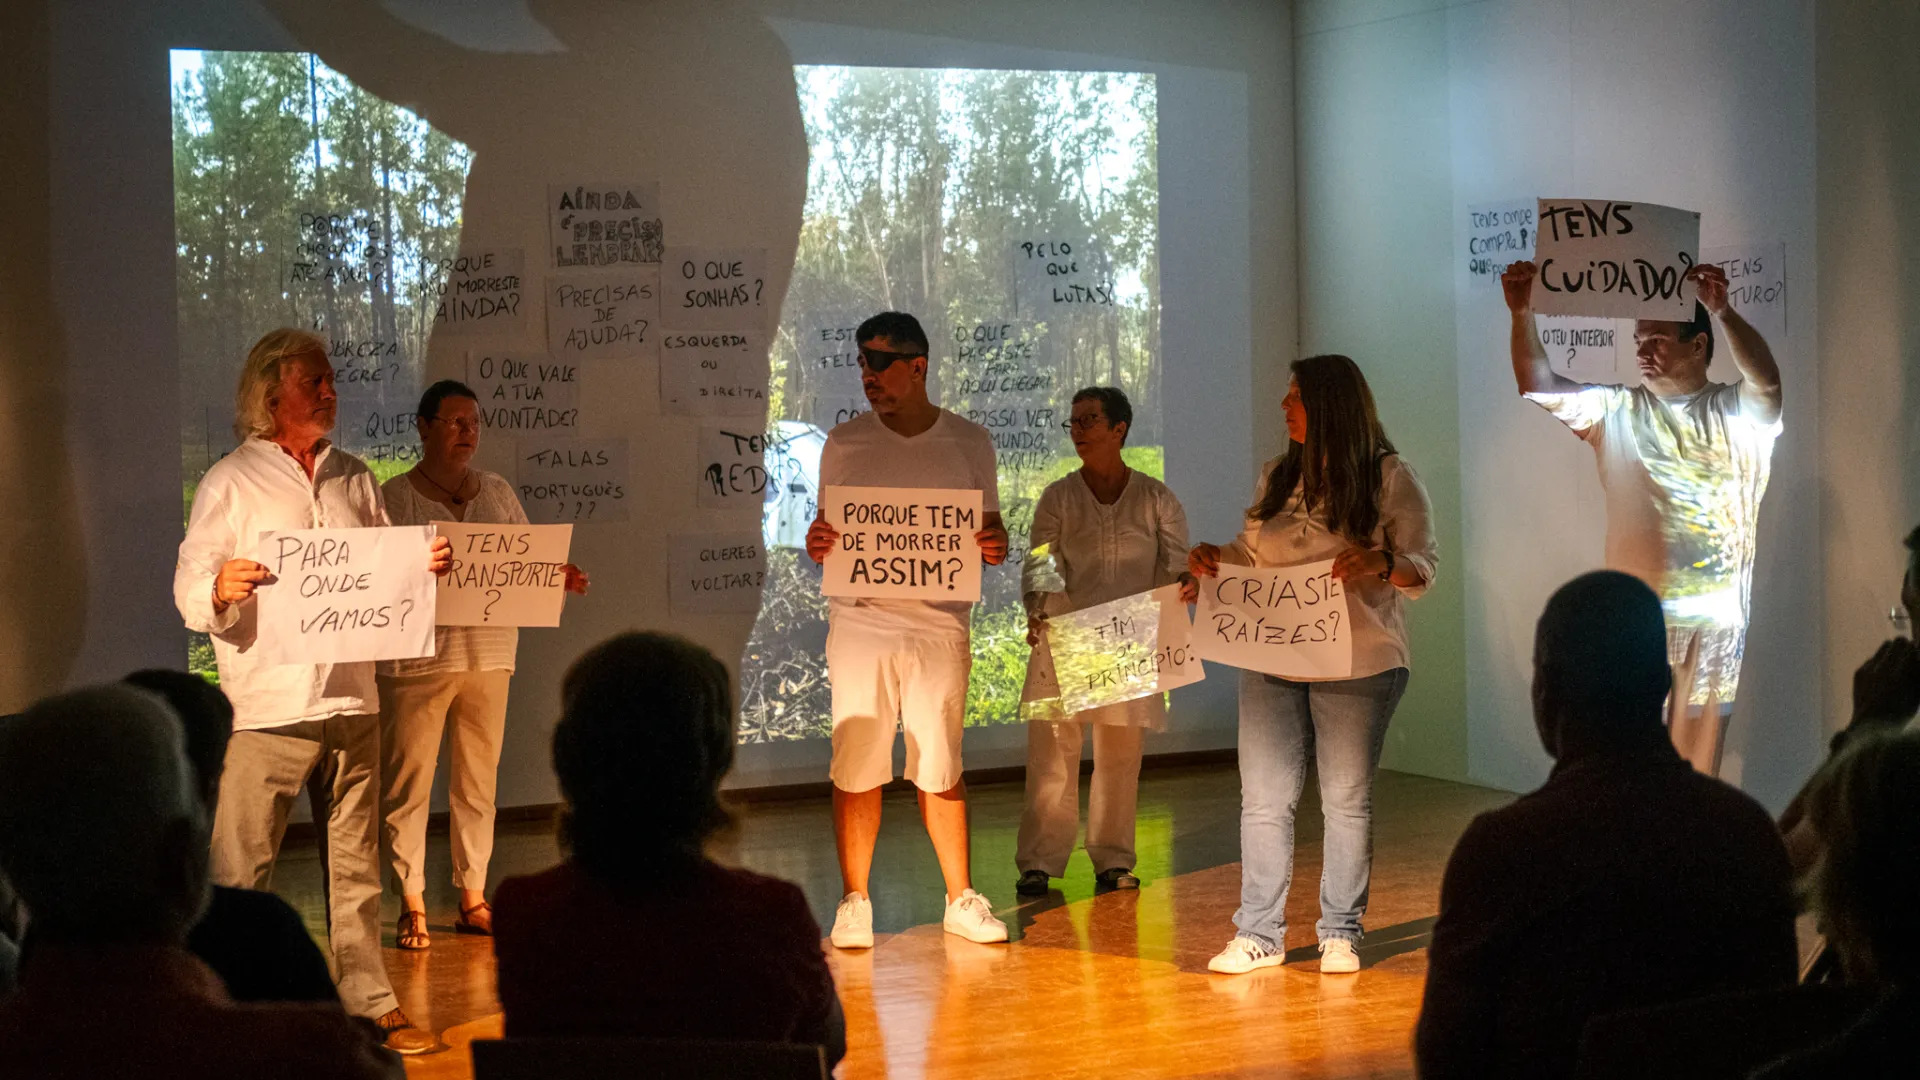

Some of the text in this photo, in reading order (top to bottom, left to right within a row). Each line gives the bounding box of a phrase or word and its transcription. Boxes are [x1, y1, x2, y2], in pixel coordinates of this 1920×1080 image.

[1540, 201, 1634, 241] TENS
[1021, 242, 1071, 259] PELO
[419, 254, 494, 280] PORQUE
[682, 260, 744, 280] O QUE
[1046, 262, 1078, 276] QUE
[457, 276, 520, 295] MORRESTE
[556, 284, 652, 308] PRECISAS
[1053, 281, 1113, 307] LUTAS?
[1730, 281, 1783, 307] TURO?
[592, 307, 616, 323] DE
[564, 320, 648, 350] AJUDA?
[821, 328, 858, 341] EST
[956, 324, 1010, 342] O QUE
[1543, 329, 1614, 348] O TEU INTERIOR
[700, 360, 718, 370] OU
[1566, 347, 1576, 369] ?
[480, 357, 576, 383] O QUE VALE
[493, 383, 544, 400] A TUA
[481, 406, 579, 429] VONTADE?
[967, 409, 1054, 428] POSSO VER
[526, 448, 609, 468] FALAS
[843, 502, 974, 529] PORQUE TEM
[466, 532, 530, 555] TENS
[700, 545, 757, 561] QUERES
[842, 532, 962, 552] DE MORRER
[275, 536, 350, 575] PARA
[299, 572, 372, 598] ONDE
[436, 559, 564, 589] RANSPORTE
[849, 557, 964, 591] ASSIM?
[483, 589, 502, 622] ?
[1212, 610, 1341, 645] RAÍZES?
